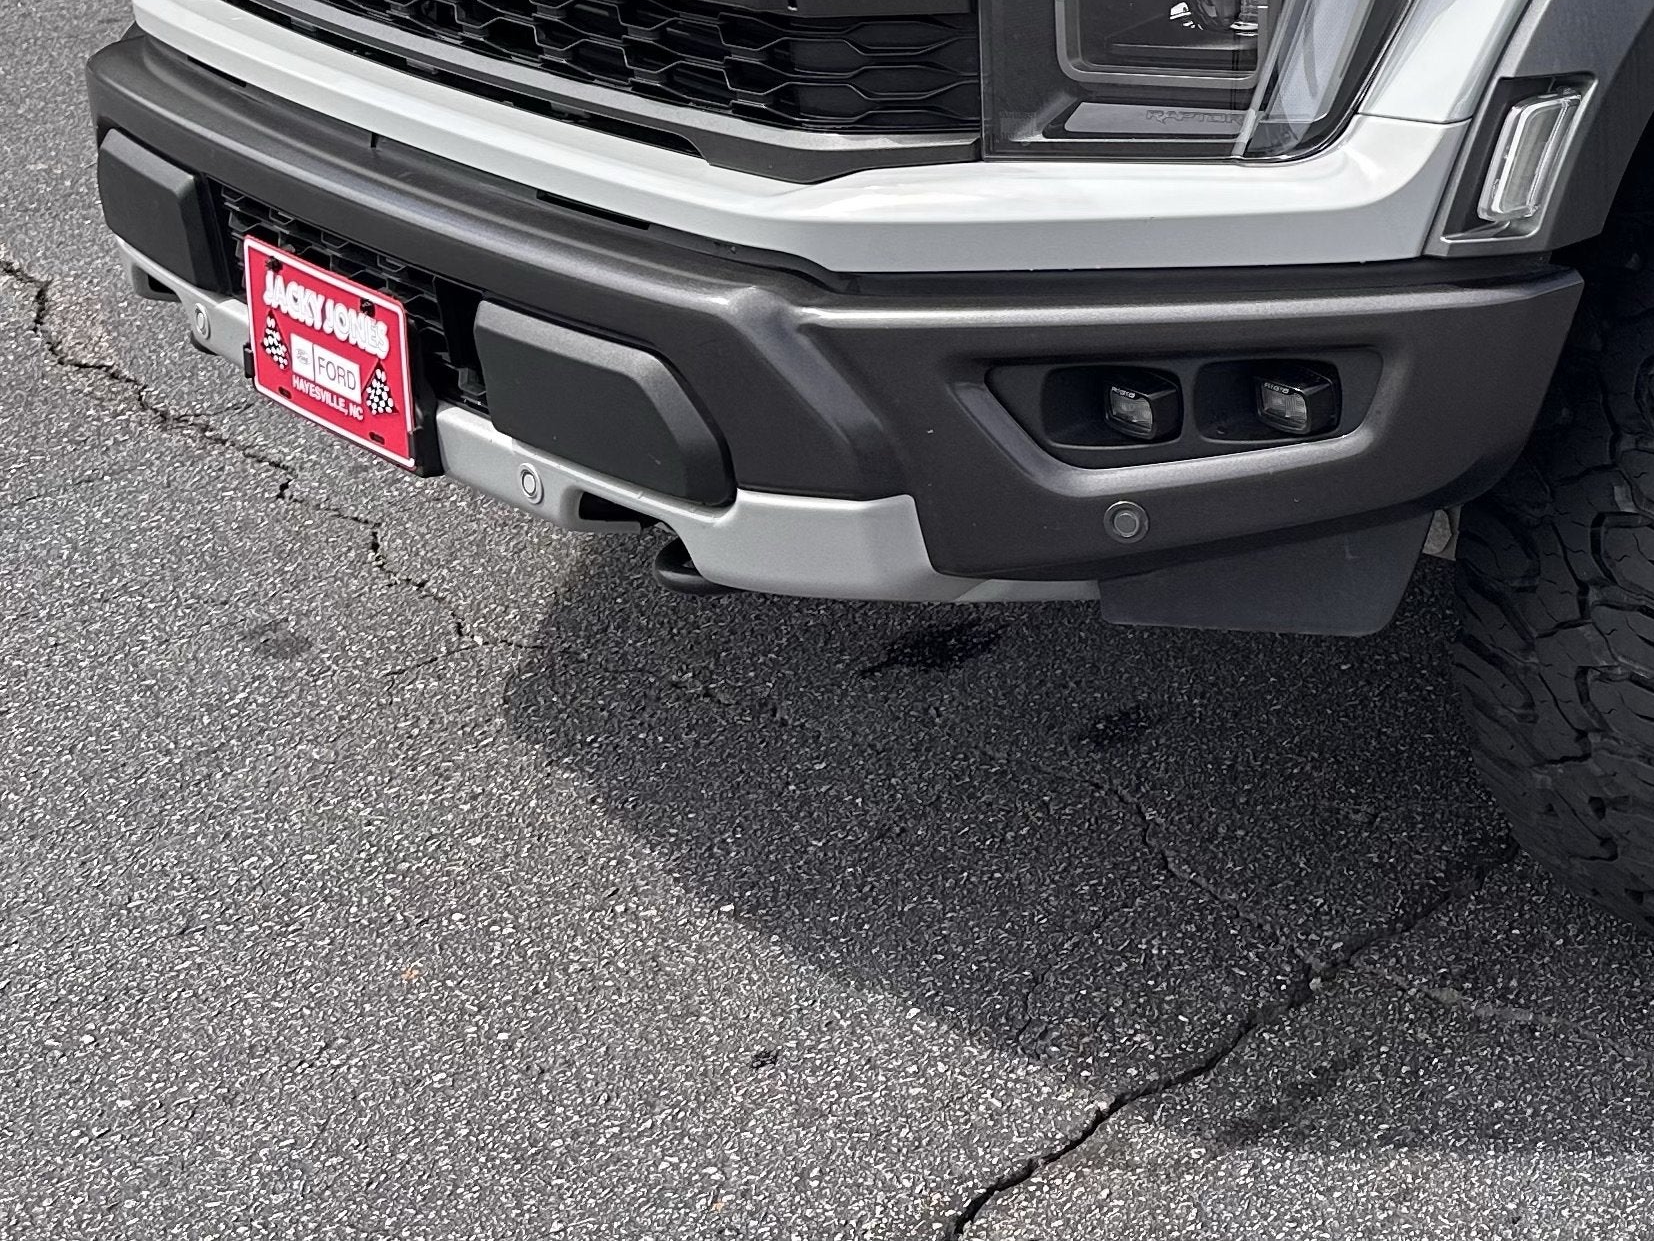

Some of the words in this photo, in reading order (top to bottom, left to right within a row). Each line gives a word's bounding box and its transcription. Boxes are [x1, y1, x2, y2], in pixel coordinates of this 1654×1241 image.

[263, 270, 325, 330] JACKY
[323, 298, 390, 360] JONES
[318, 356, 357, 391] FORD
[292, 374, 349, 416] HAYESVILLE,
[348, 402, 364, 421] NC
